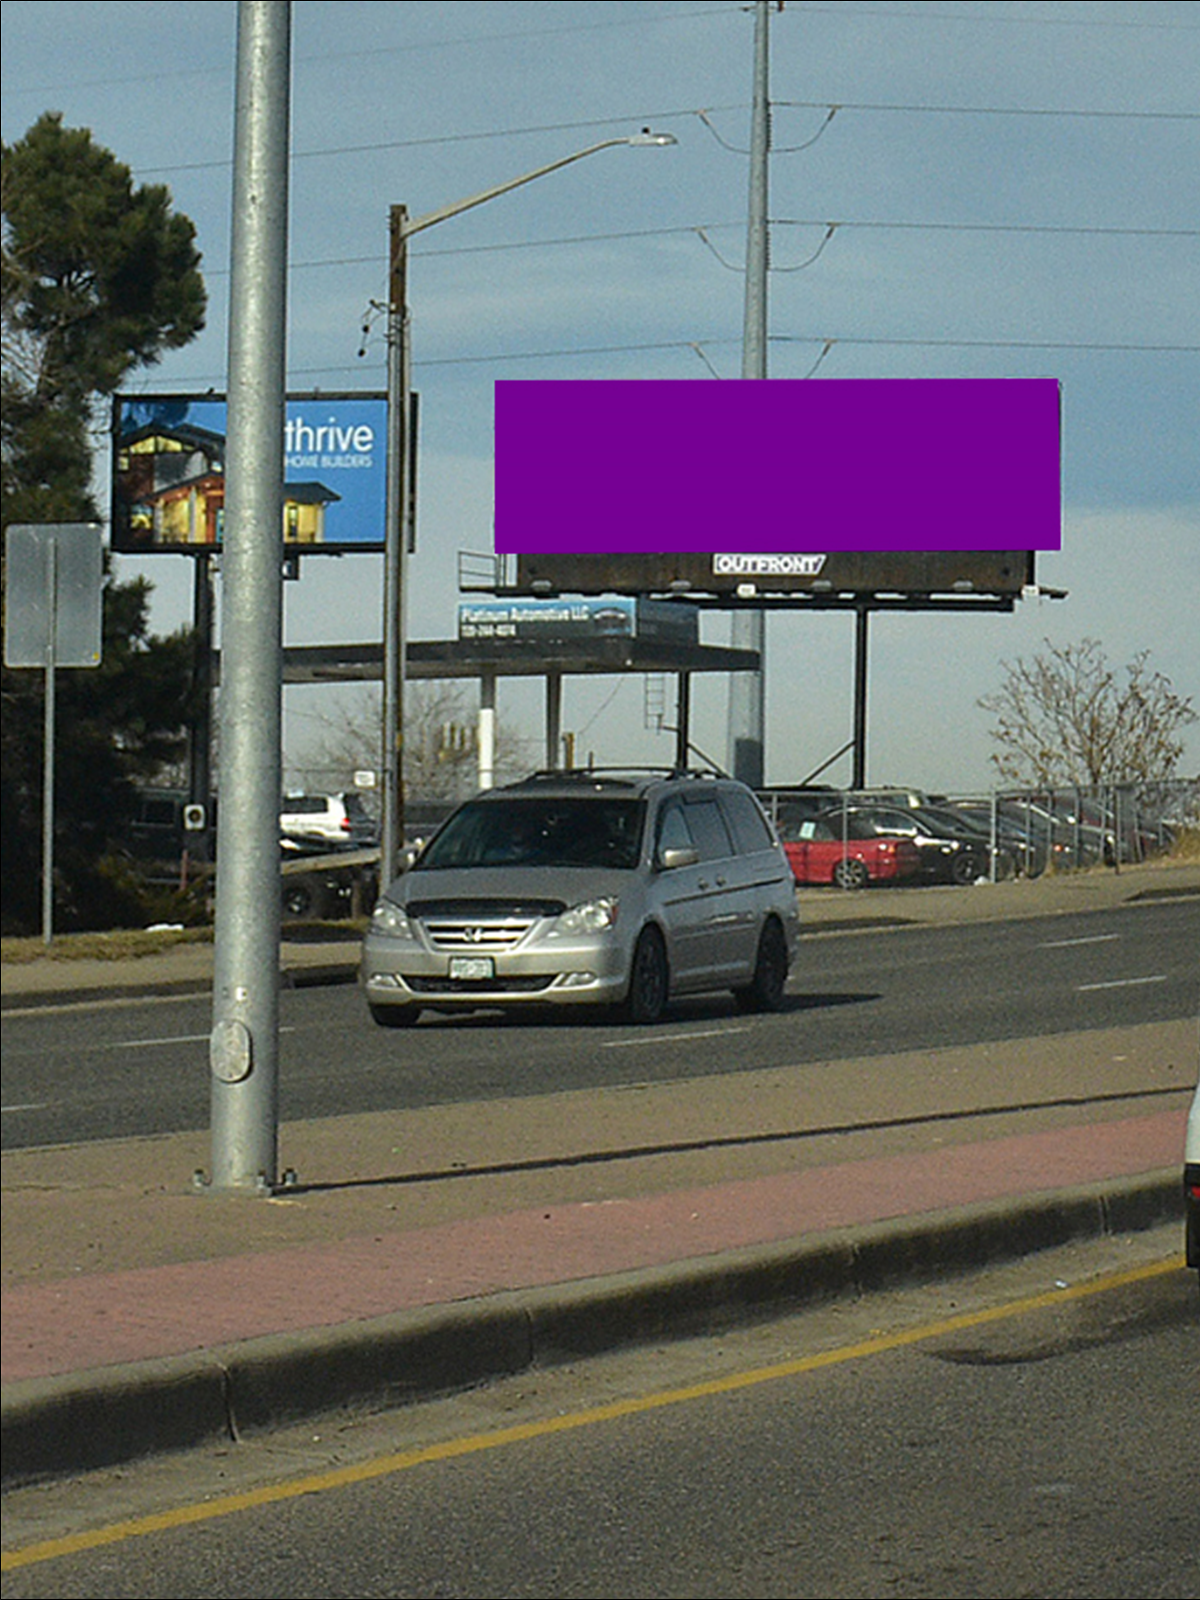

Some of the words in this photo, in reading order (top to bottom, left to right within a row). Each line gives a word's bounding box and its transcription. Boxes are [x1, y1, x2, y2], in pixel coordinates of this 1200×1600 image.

[284, 416, 374, 452] thrive
[284, 454, 318, 468] HOME
[321, 454, 374, 469] BUILDERS
[717, 555, 824, 572] OUTFRONT
[461, 607, 508, 623] Platinum
[510, 606, 569, 622] Automotive
[571, 604, 589, 621] LLC
